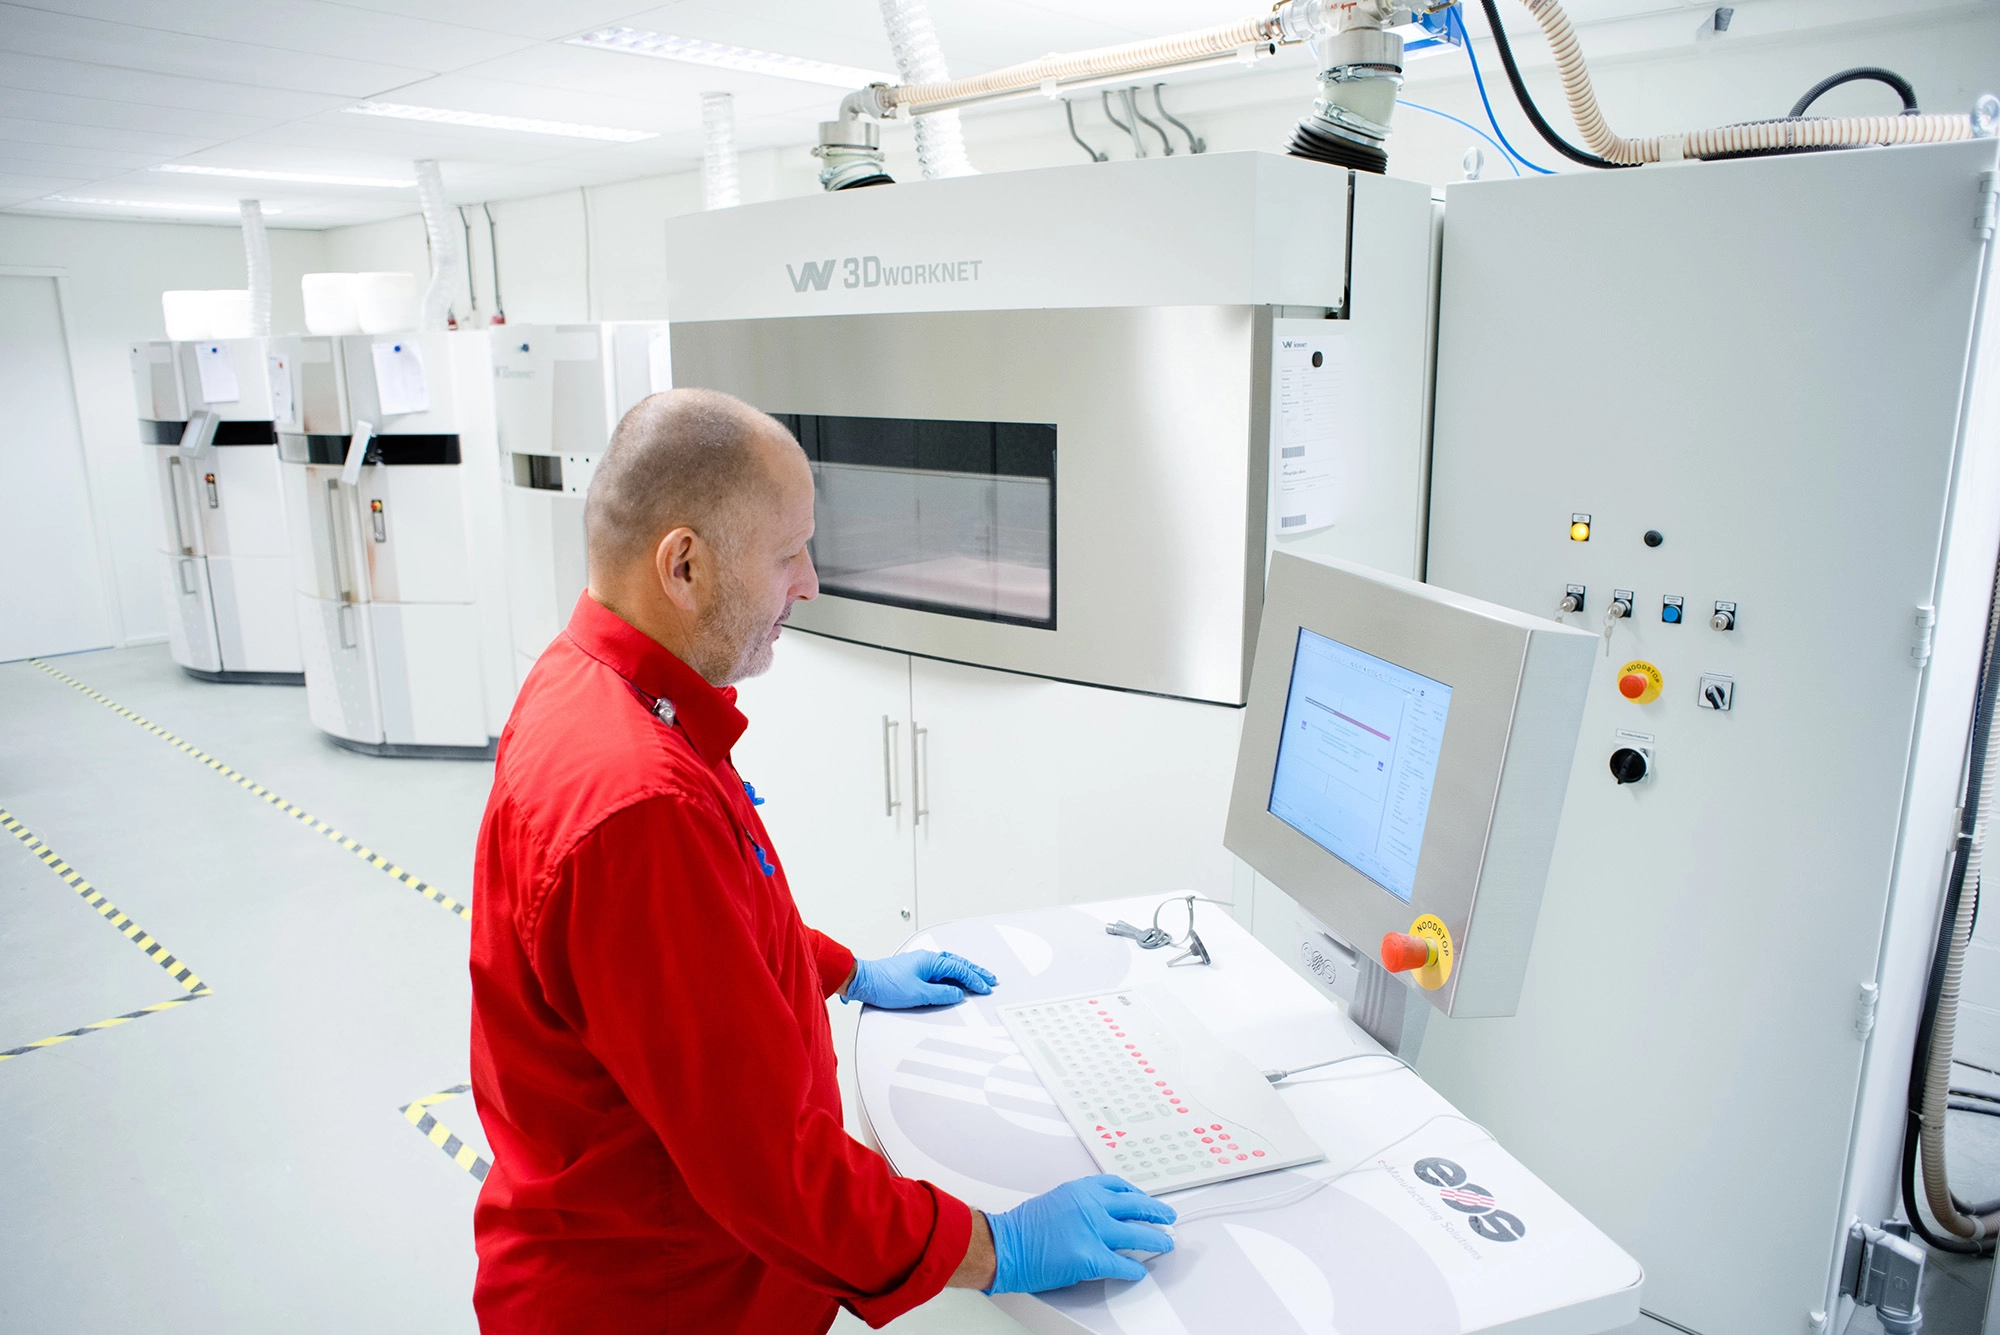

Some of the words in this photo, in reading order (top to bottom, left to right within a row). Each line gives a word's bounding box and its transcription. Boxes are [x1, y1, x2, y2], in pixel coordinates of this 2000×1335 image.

[1626, 663, 1660, 683] NOODSTOP
[1416, 920, 1450, 957] NOODSTOP
[1377, 1159, 1443, 1222] e-Manufacturing
[1440, 1220, 1483, 1261] Solutions
[1413, 1156, 1526, 1243] eos
